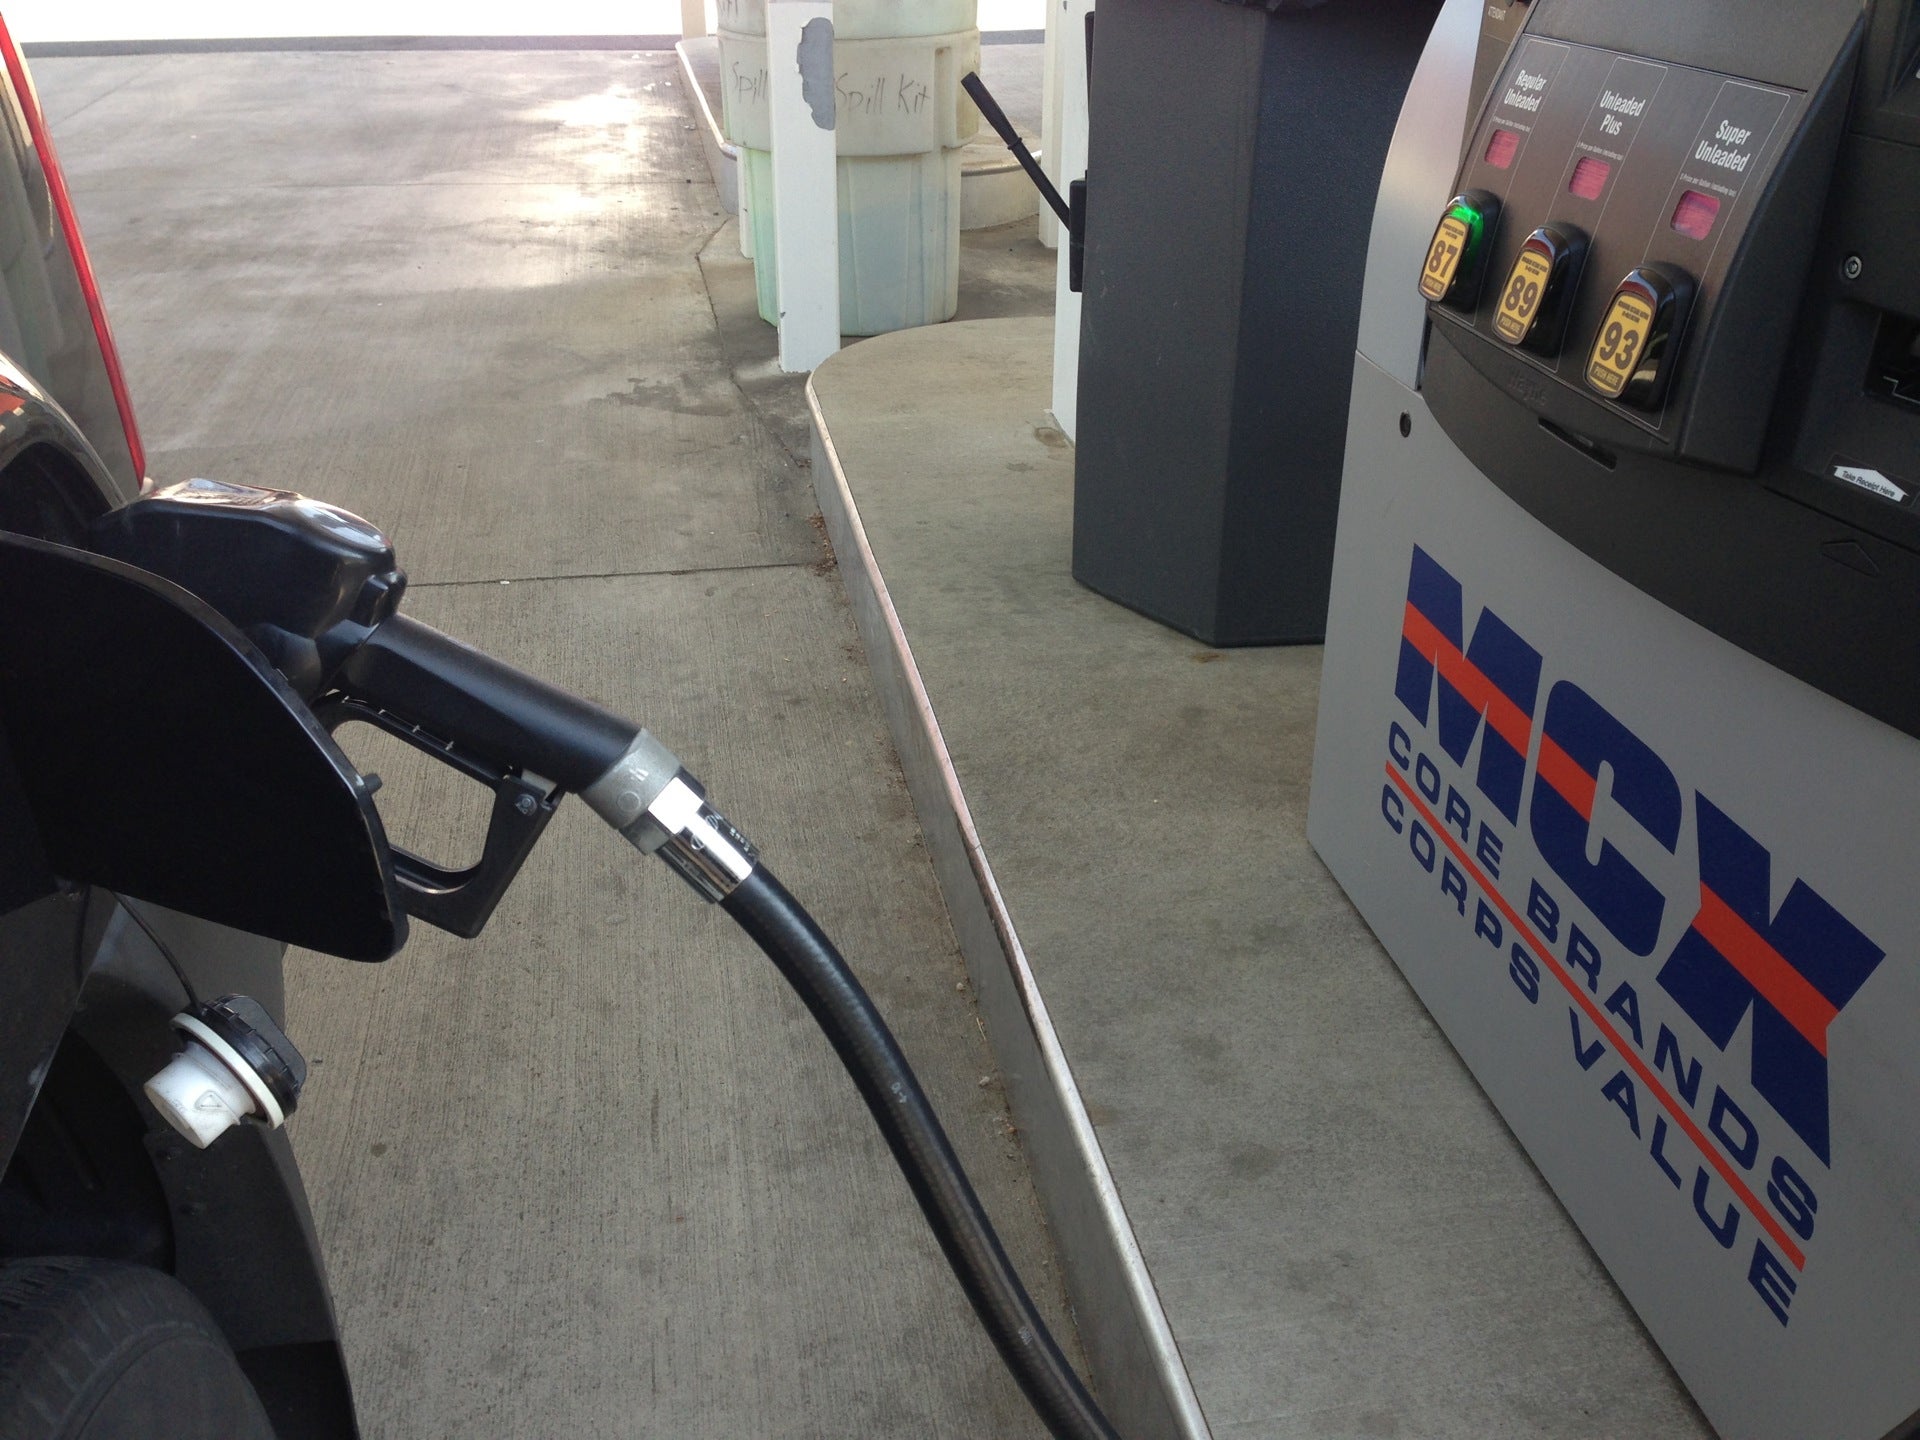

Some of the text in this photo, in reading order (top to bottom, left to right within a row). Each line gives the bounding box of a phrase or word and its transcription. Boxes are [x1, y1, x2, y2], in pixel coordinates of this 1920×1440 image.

[836, 72, 931, 114] Spill Kit
[1515, 69, 1548, 92] Regular
[1504, 88, 1542, 112] Unleaded
[1600, 90, 1646, 117] Unleaded
[1600, 114, 1623, 136] Plus
[1715, 119, 1752, 146] Super
[1695, 140, 1751, 172] Unleaded
[1429, 240, 1458, 278] 87
[1505, 274, 1538, 318] 89
[1599, 321, 1639, 370] 93
[1856, 476, 1880, 491] Receipt
[1879, 485, 1895, 497] Here
[1394, 543, 1887, 1170] MCX
[1389, 721, 1818, 1240] CORE BRANDS
[1381, 783, 1798, 1328] CORPS VALUE
